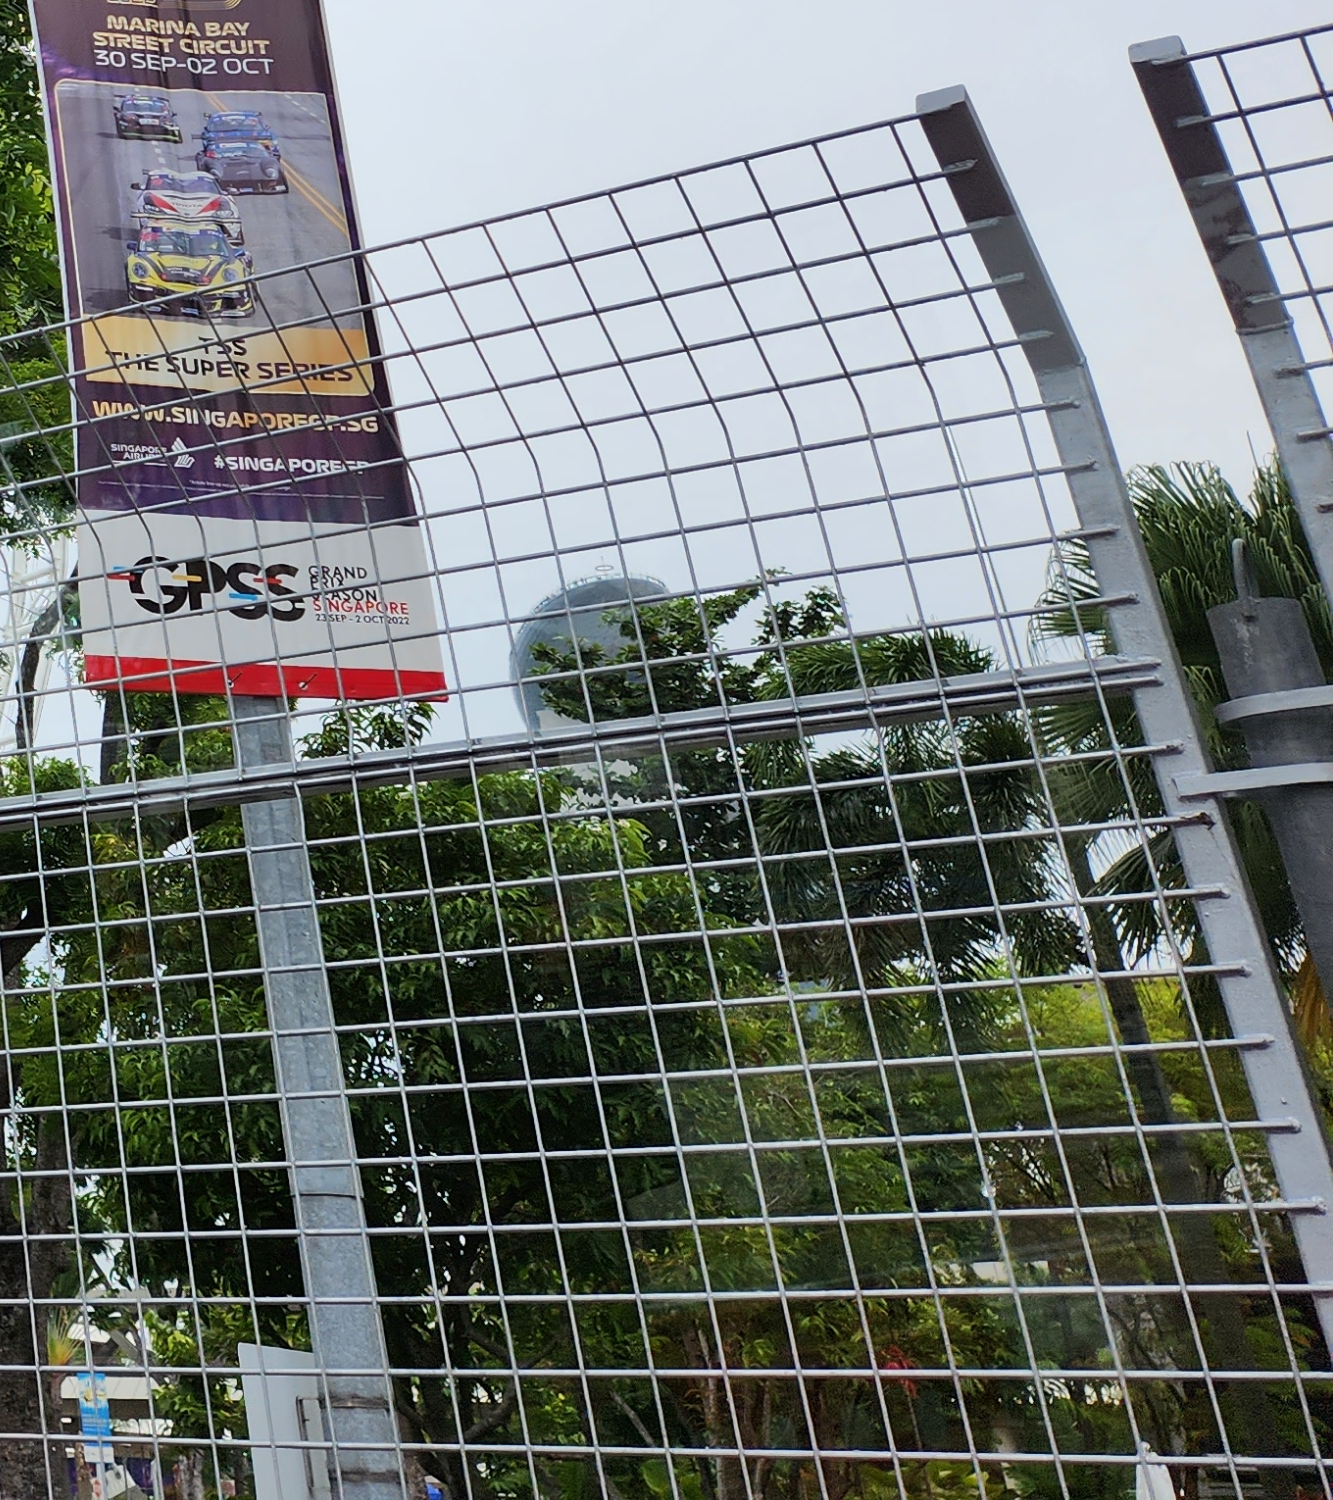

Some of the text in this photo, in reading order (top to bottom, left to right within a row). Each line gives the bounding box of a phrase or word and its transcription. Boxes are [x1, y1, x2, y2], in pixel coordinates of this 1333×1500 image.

[107, 14, 251, 37] MARINA BAY
[92, 31, 271, 55] STREET CIRCUIT
[93, 49, 275, 75] 30 SEP-02 OCT
[198, 336, 249, 356] TSS
[105, 350, 353, 382] THE SUPER SERIES
[308, 565, 367, 580] GRAND
[129, 555, 306, 622] GPSS
[312, 588, 378, 602] SASON
[312, 599, 410, 615] SNGAPORE
[315, 613, 328, 622] 23
[328, 614, 347, 623] SEP
[355, 615, 361, 623] 2
[364, 615, 385, 624] OCT
[387, 616, 410, 626] 2022
